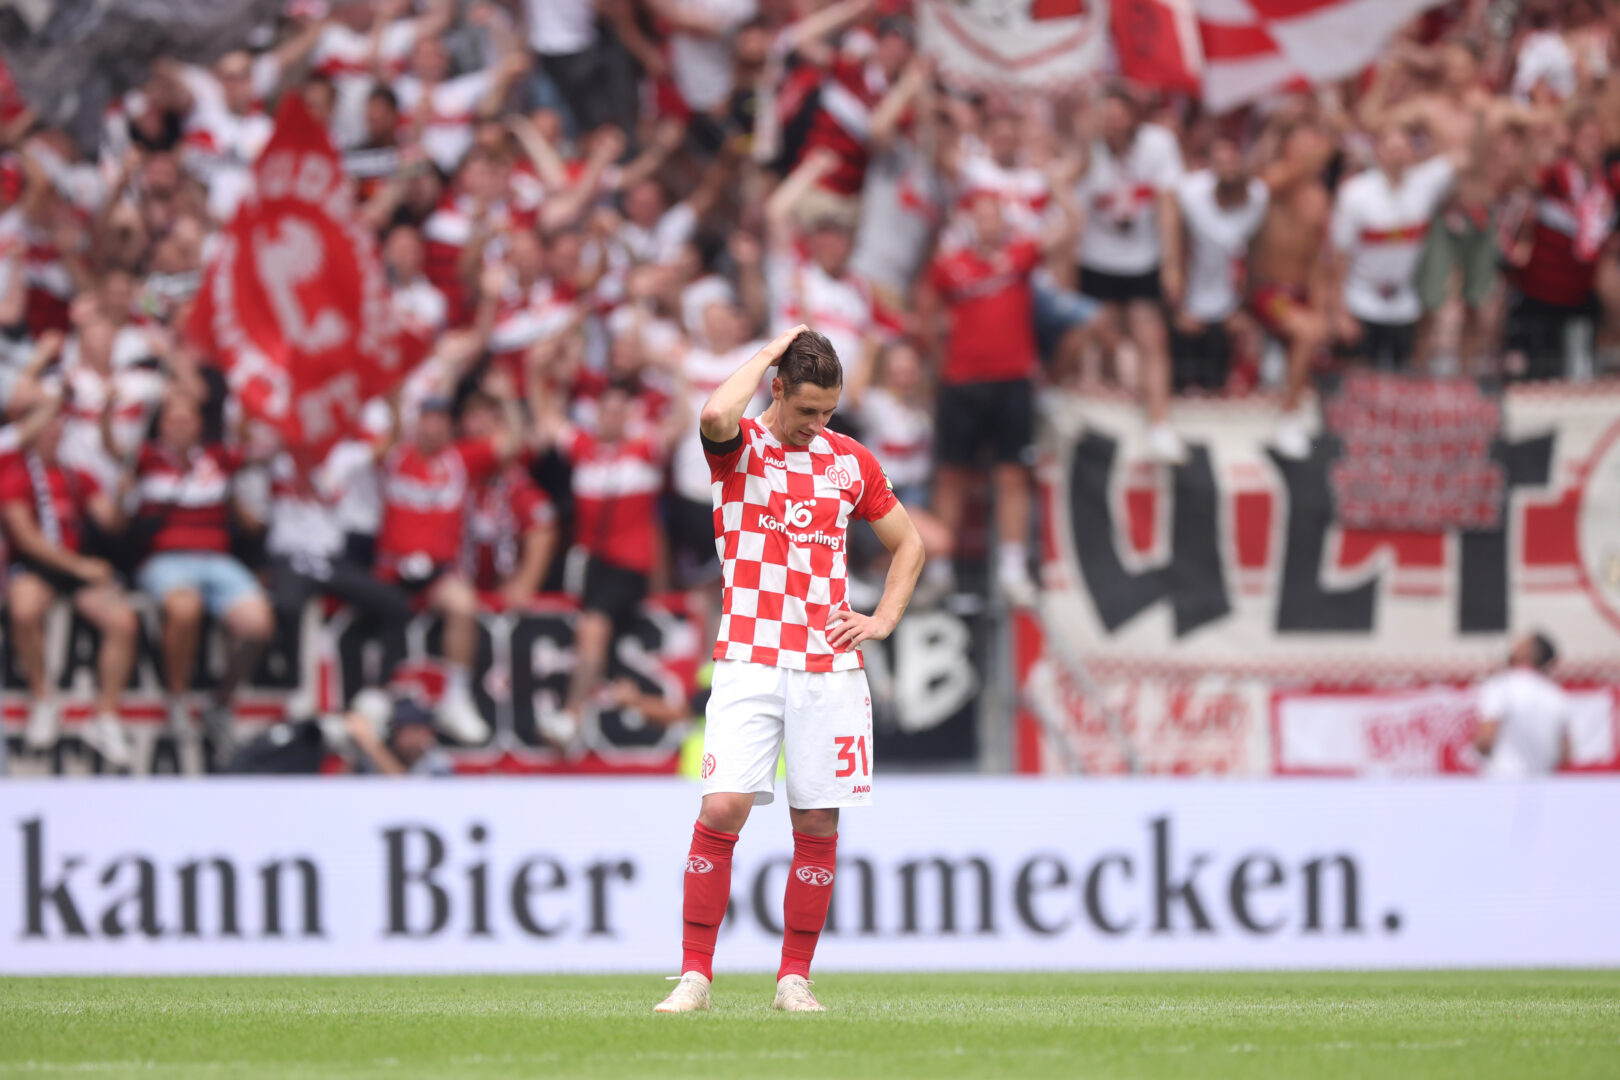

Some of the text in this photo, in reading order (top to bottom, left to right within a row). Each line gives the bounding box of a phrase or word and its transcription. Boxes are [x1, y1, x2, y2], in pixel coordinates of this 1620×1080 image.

[764, 456, 786, 468] JAKO
[834, 735, 869, 778] 31
[852, 785, 871, 794] JAKO
[18, 813, 1405, 940] kann Bier cmecken.
